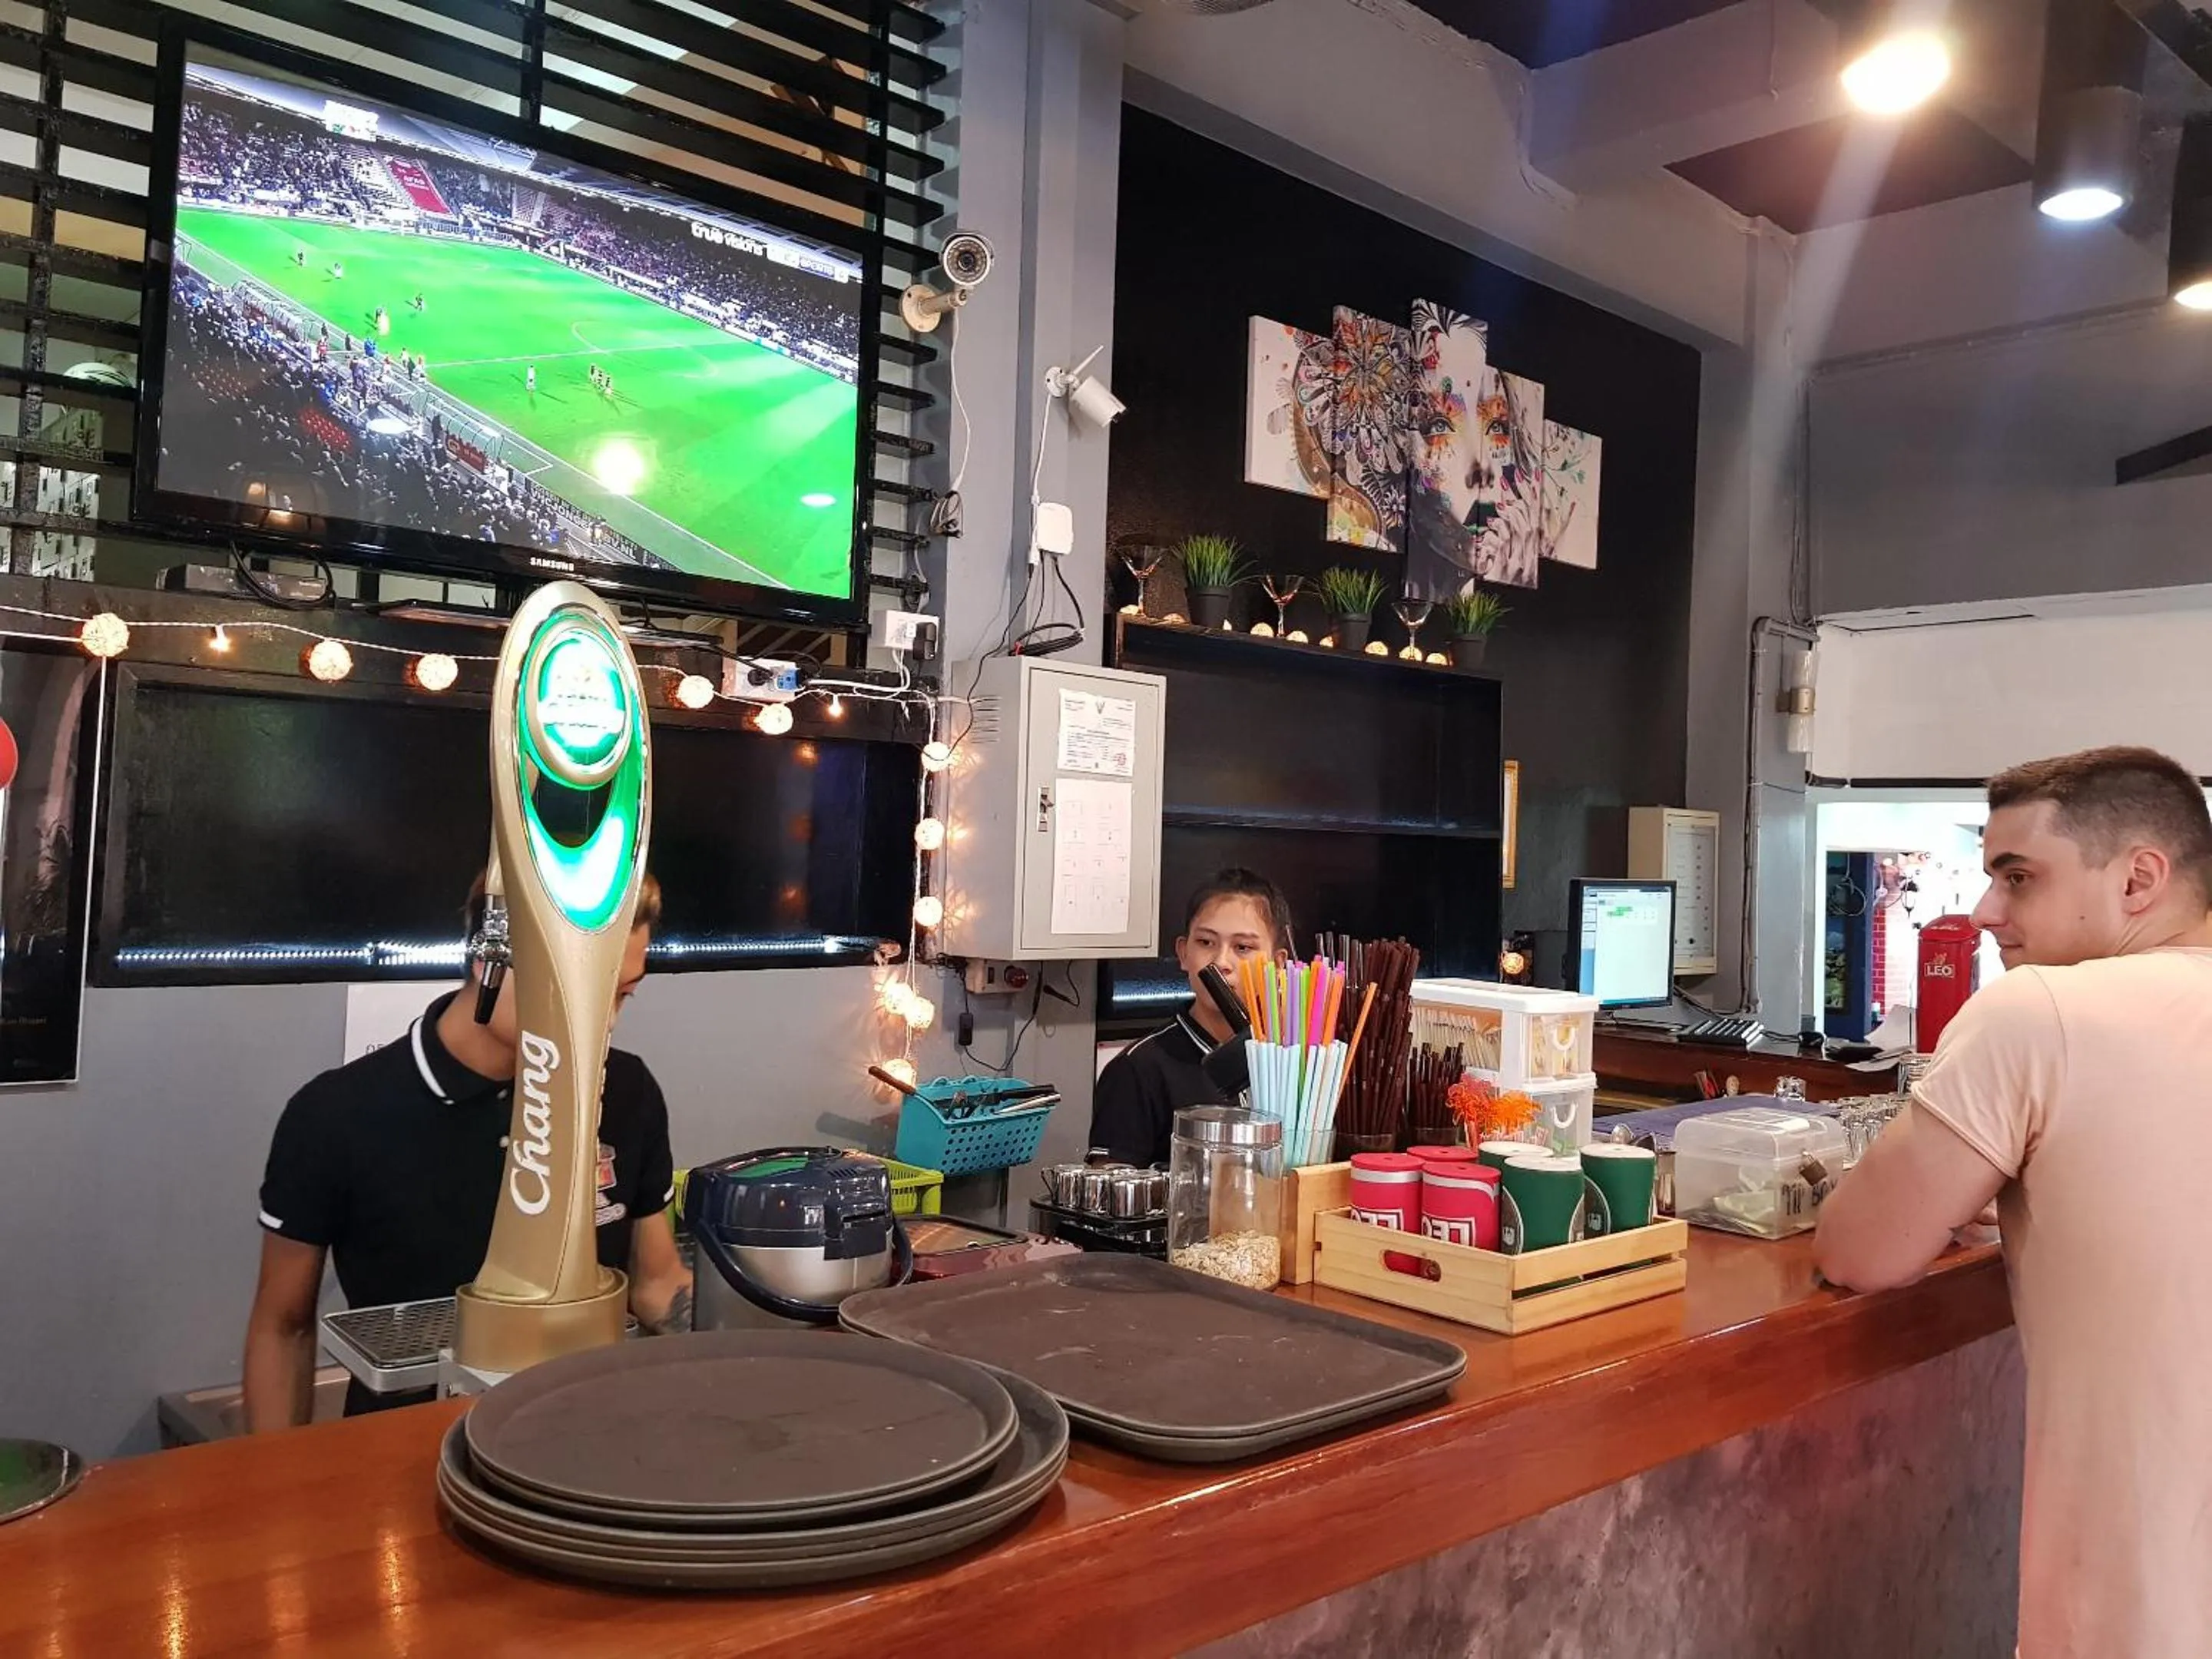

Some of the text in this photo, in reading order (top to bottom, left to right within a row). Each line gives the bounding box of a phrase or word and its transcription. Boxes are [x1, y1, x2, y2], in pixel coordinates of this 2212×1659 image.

[530, 557, 574, 571] SAMSUNG
[1926, 965, 1952, 976] LEO
[510, 1031, 560, 1214] Chang
